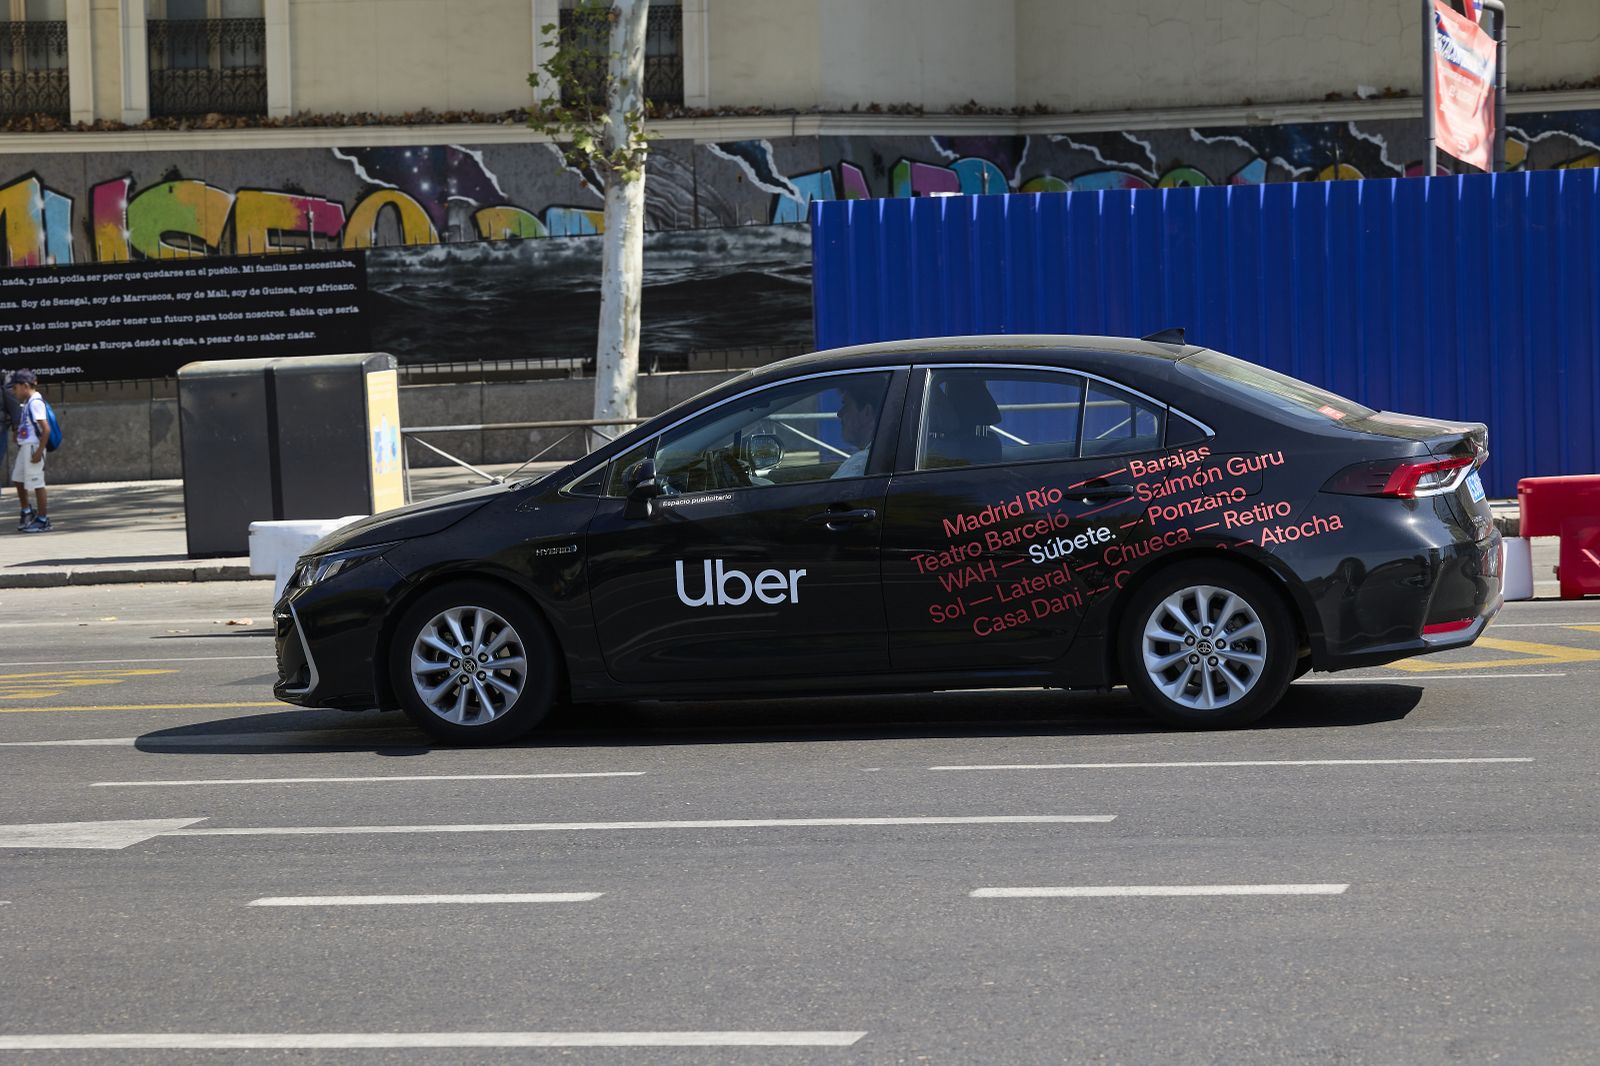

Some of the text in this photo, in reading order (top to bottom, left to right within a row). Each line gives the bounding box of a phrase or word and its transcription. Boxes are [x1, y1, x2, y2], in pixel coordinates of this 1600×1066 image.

[3, 277, 27, 286] nada,
[37, 275, 59, 285] nada
[87, 274, 101, 282] ser
[103, 273, 123, 283] peor
[125, 272, 141, 281] que
[143, 269, 183, 280] quedarse
[208, 266, 240, 277] pueblo.
[256, 263, 287, 273] familia
[305, 259, 355, 270] necesitaba,
[22, 299, 38, 309] Soy
[53, 296, 90, 307] Senegal,
[93, 296, 108, 306] soy
[123, 293, 174, 303] Marruecos,
[177, 292, 191, 301] soy
[232, 289, 247, 298] soy
[262, 286, 297, 296] Guinea,
[299, 285, 314, 295] soy
[317, 283, 356, 293] africano.
[33, 322, 45, 330] los
[72, 320, 93, 330] para
[95, 318, 121, 329] poder
[123, 317, 148, 326] tener
[165, 314, 193, 323] futuro
[196, 314, 216, 323] para
[219, 311, 243, 321] todos
[246, 310, 287, 319] nosotros.
[317, 307, 333, 317] que
[2, 347, 18, 356] que
[21, 344, 54, 354] hacerlo
[64, 343, 90, 352] llegar
[100, 341, 133, 350] Europa
[135, 338, 160, 348] desde
[173, 337, 197, 347] agua,
[207, 335, 232, 346] pesar
[260, 332, 285, 341] saber
[288, 330, 316, 340] nadar.
[662, 499, 690, 507] Espacio
[910, 451, 1285, 575] Teatro Barceló Salmón Guru
[942, 447, 1211, 538] Madrid Río Barajas
[928, 597, 966, 624] Sol
[995, 562, 1072, 603] Lateral
[1103, 527, 1192, 567] Chueca
[1223, 501, 1291, 530] Retiro
[938, 486, 1247, 593] WAH Súbete. Ponzano
[675, 559, 807, 606] Uber
[972, 514, 1344, 637] Casa Dani Atocha
